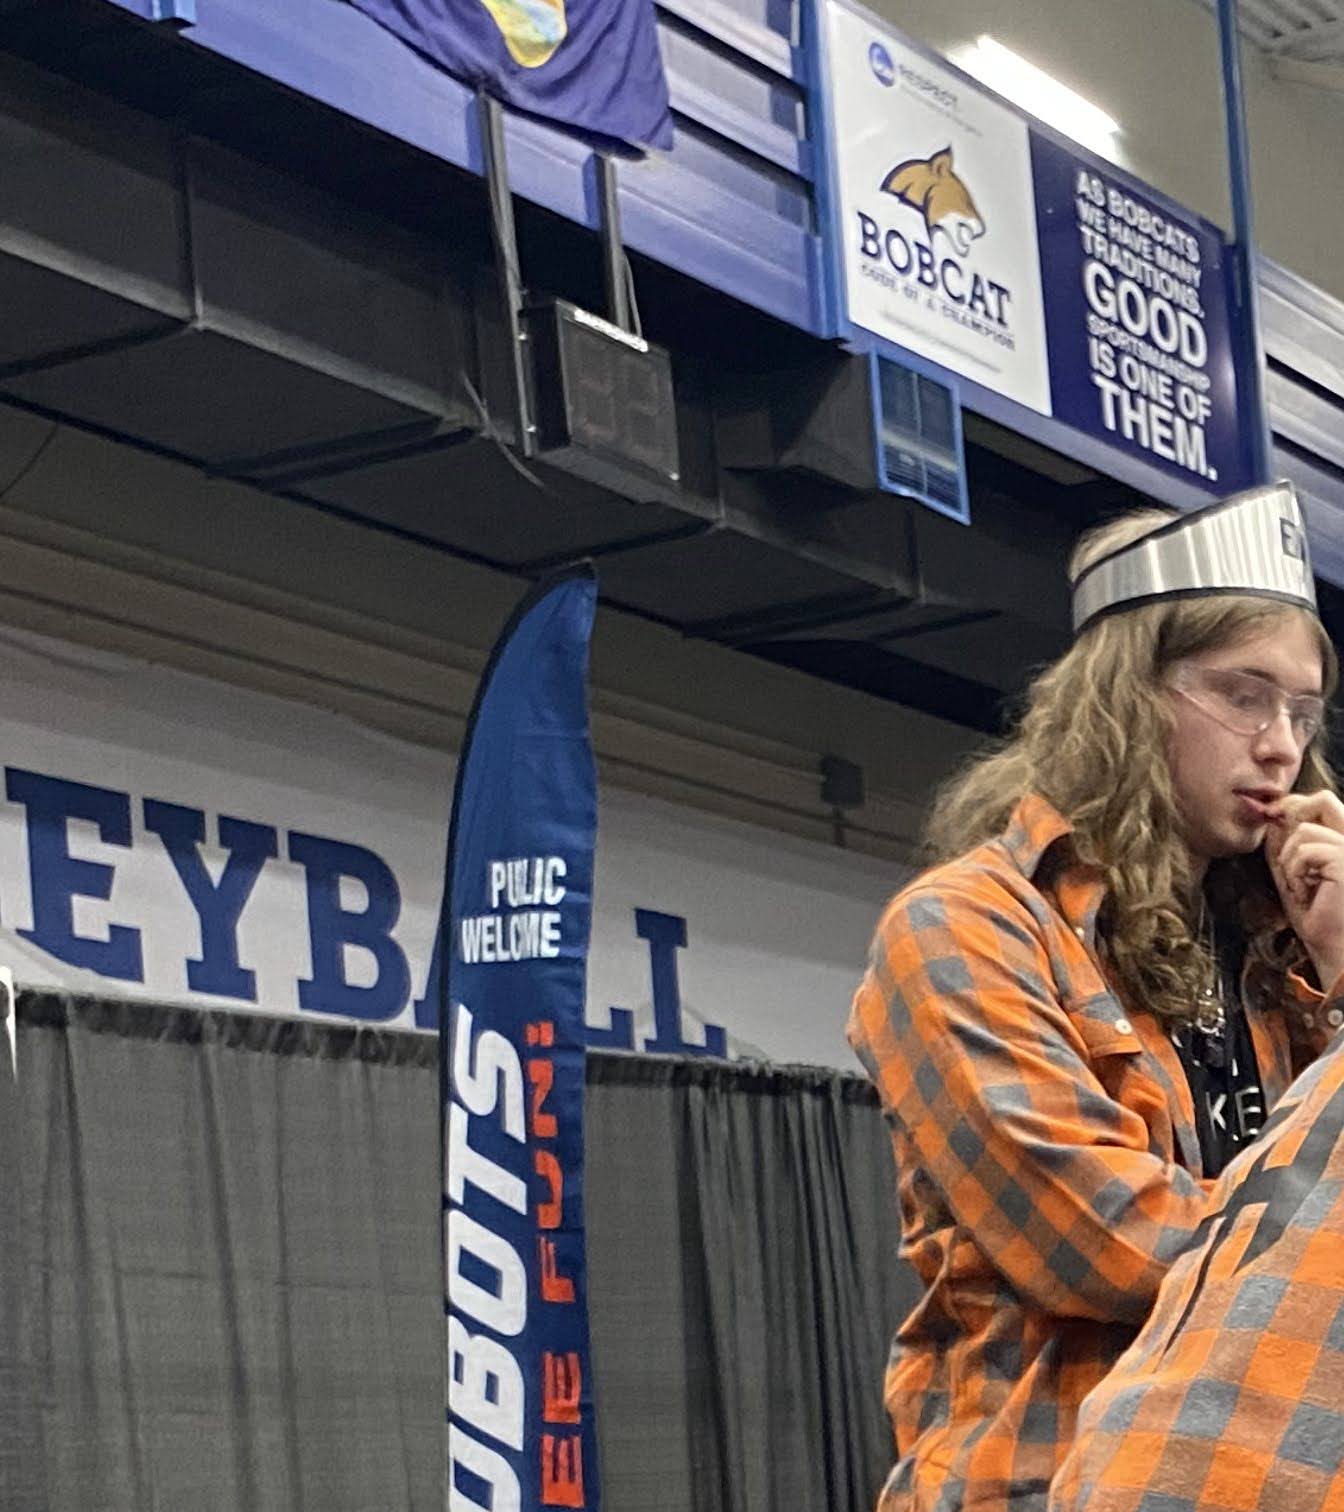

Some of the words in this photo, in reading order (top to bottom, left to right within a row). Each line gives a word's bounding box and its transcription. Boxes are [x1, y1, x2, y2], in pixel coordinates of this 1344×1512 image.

[1076, 198, 1107, 234] WE
[1107, 216, 1154, 262] HAVE
[1154, 245, 1202, 289] MANY
[1077, 171, 1105, 207] AS
[1107, 188, 1200, 264] BOBCATS
[856, 211, 1012, 327] BOBCAT
[1084, 261, 1208, 368] GOOD
[1087, 313, 1211, 392] SPORTSMANSHIP
[1089, 337, 1116, 378] IS
[1120, 354, 1175, 409] ONE
[1177, 385, 1212, 425] OF
[1092, 372, 1218, 481] THEM.
[4, 766, 727, 1058] EYBL
